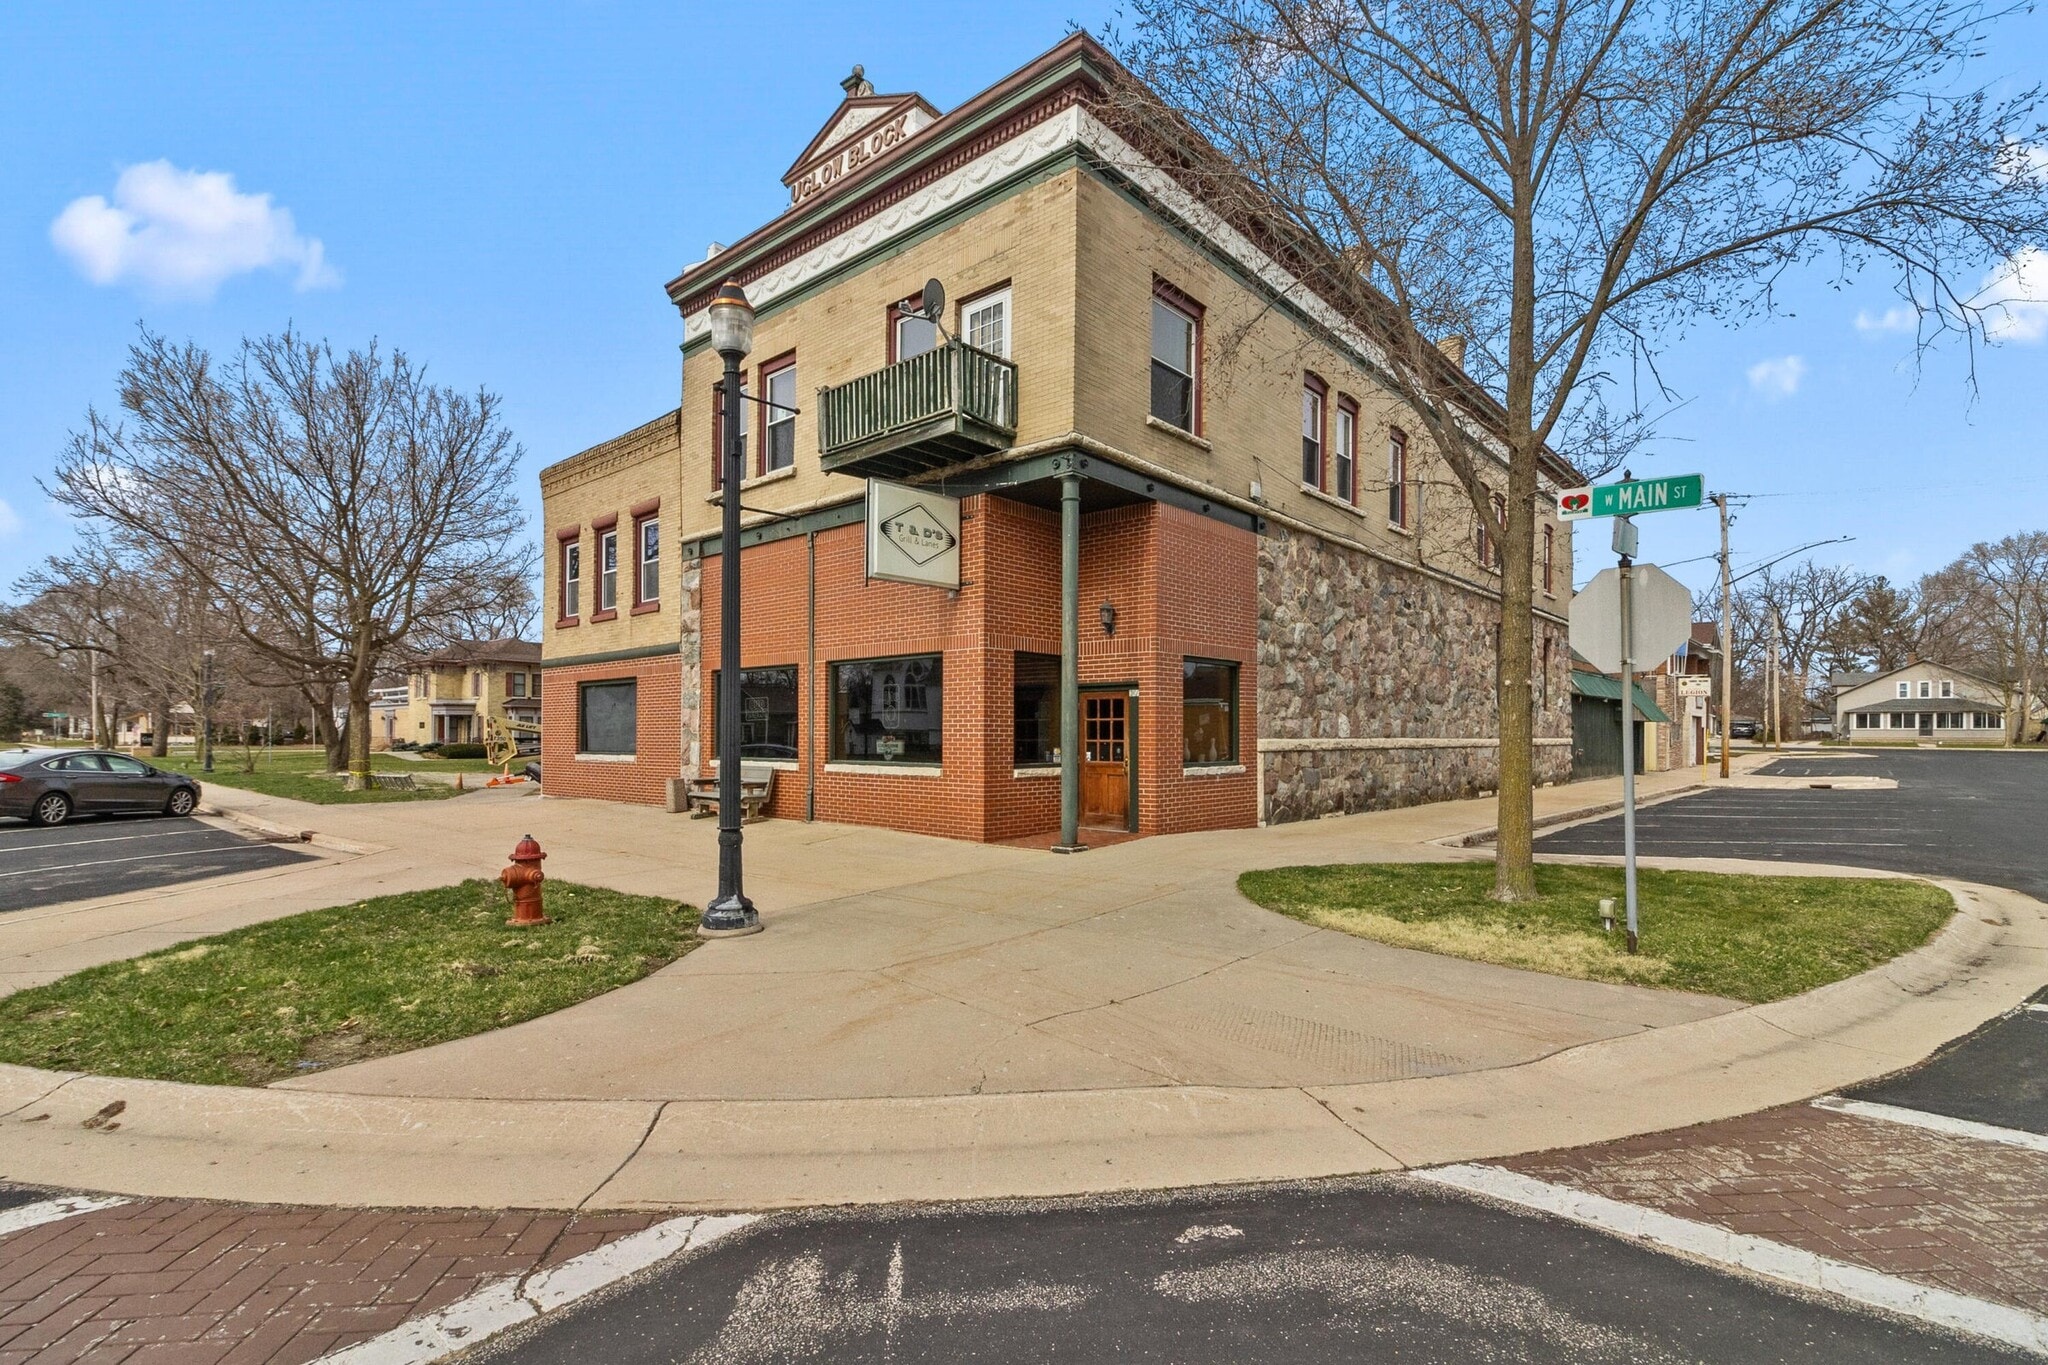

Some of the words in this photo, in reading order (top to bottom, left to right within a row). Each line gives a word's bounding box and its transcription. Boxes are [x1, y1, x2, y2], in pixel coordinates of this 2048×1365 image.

[791, 154, 844, 203] UGLOW
[847, 114, 908, 170] BLOCK
[1605, 494, 1614, 507] W
[1618, 482, 1668, 511] MAIN
[1673, 485, 1687, 499] ST
[895, 521, 904, 533] T
[909, 524, 919, 536] &
